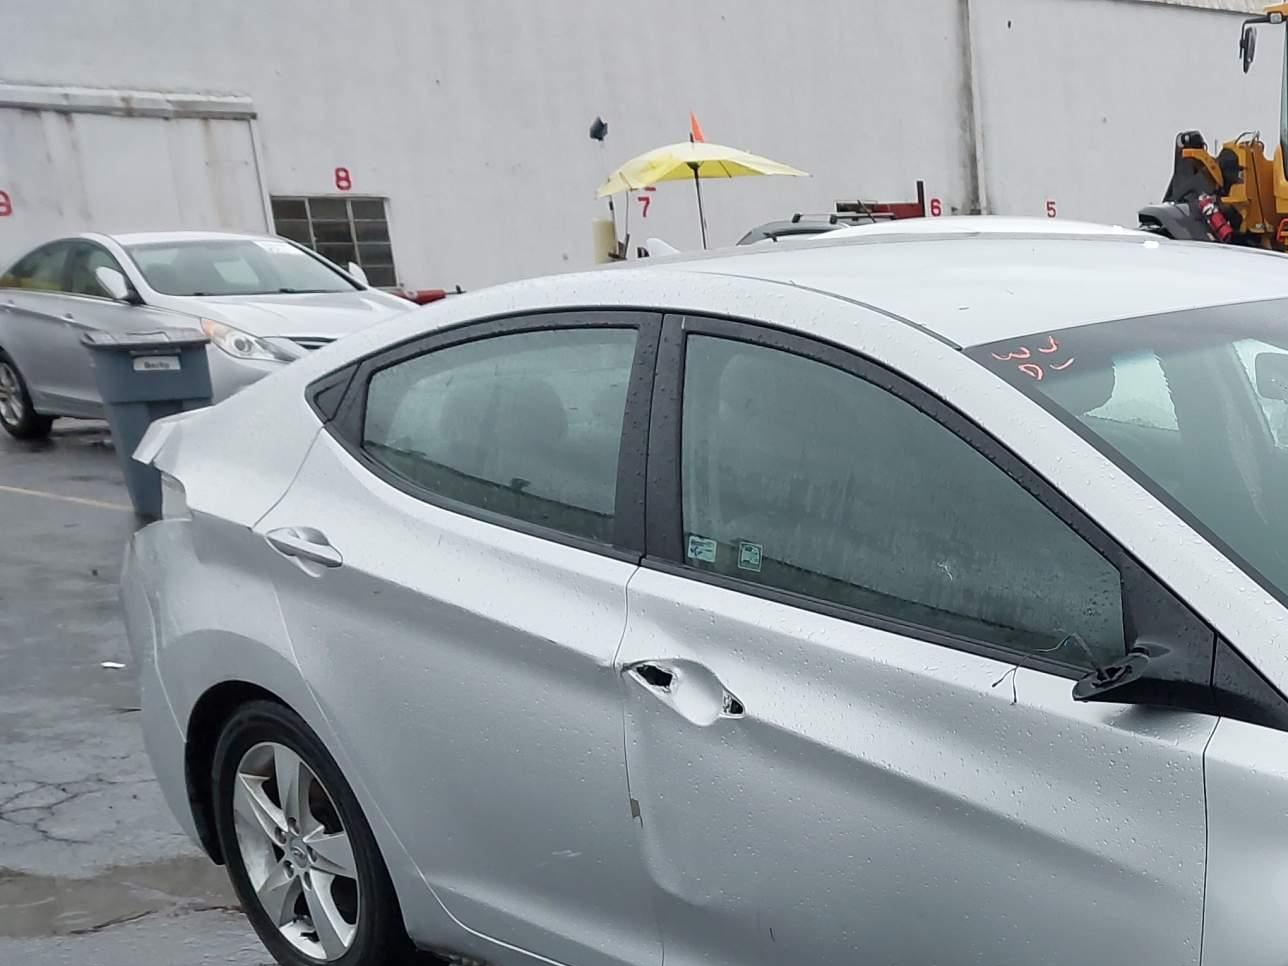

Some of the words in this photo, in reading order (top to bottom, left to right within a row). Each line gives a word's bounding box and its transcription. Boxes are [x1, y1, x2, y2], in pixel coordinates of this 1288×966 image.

[335, 167, 352, 190] 8
[637, 196, 650, 218] 7
[930, 198, 942, 217] 6
[1046, 200, 1057, 218] 5
